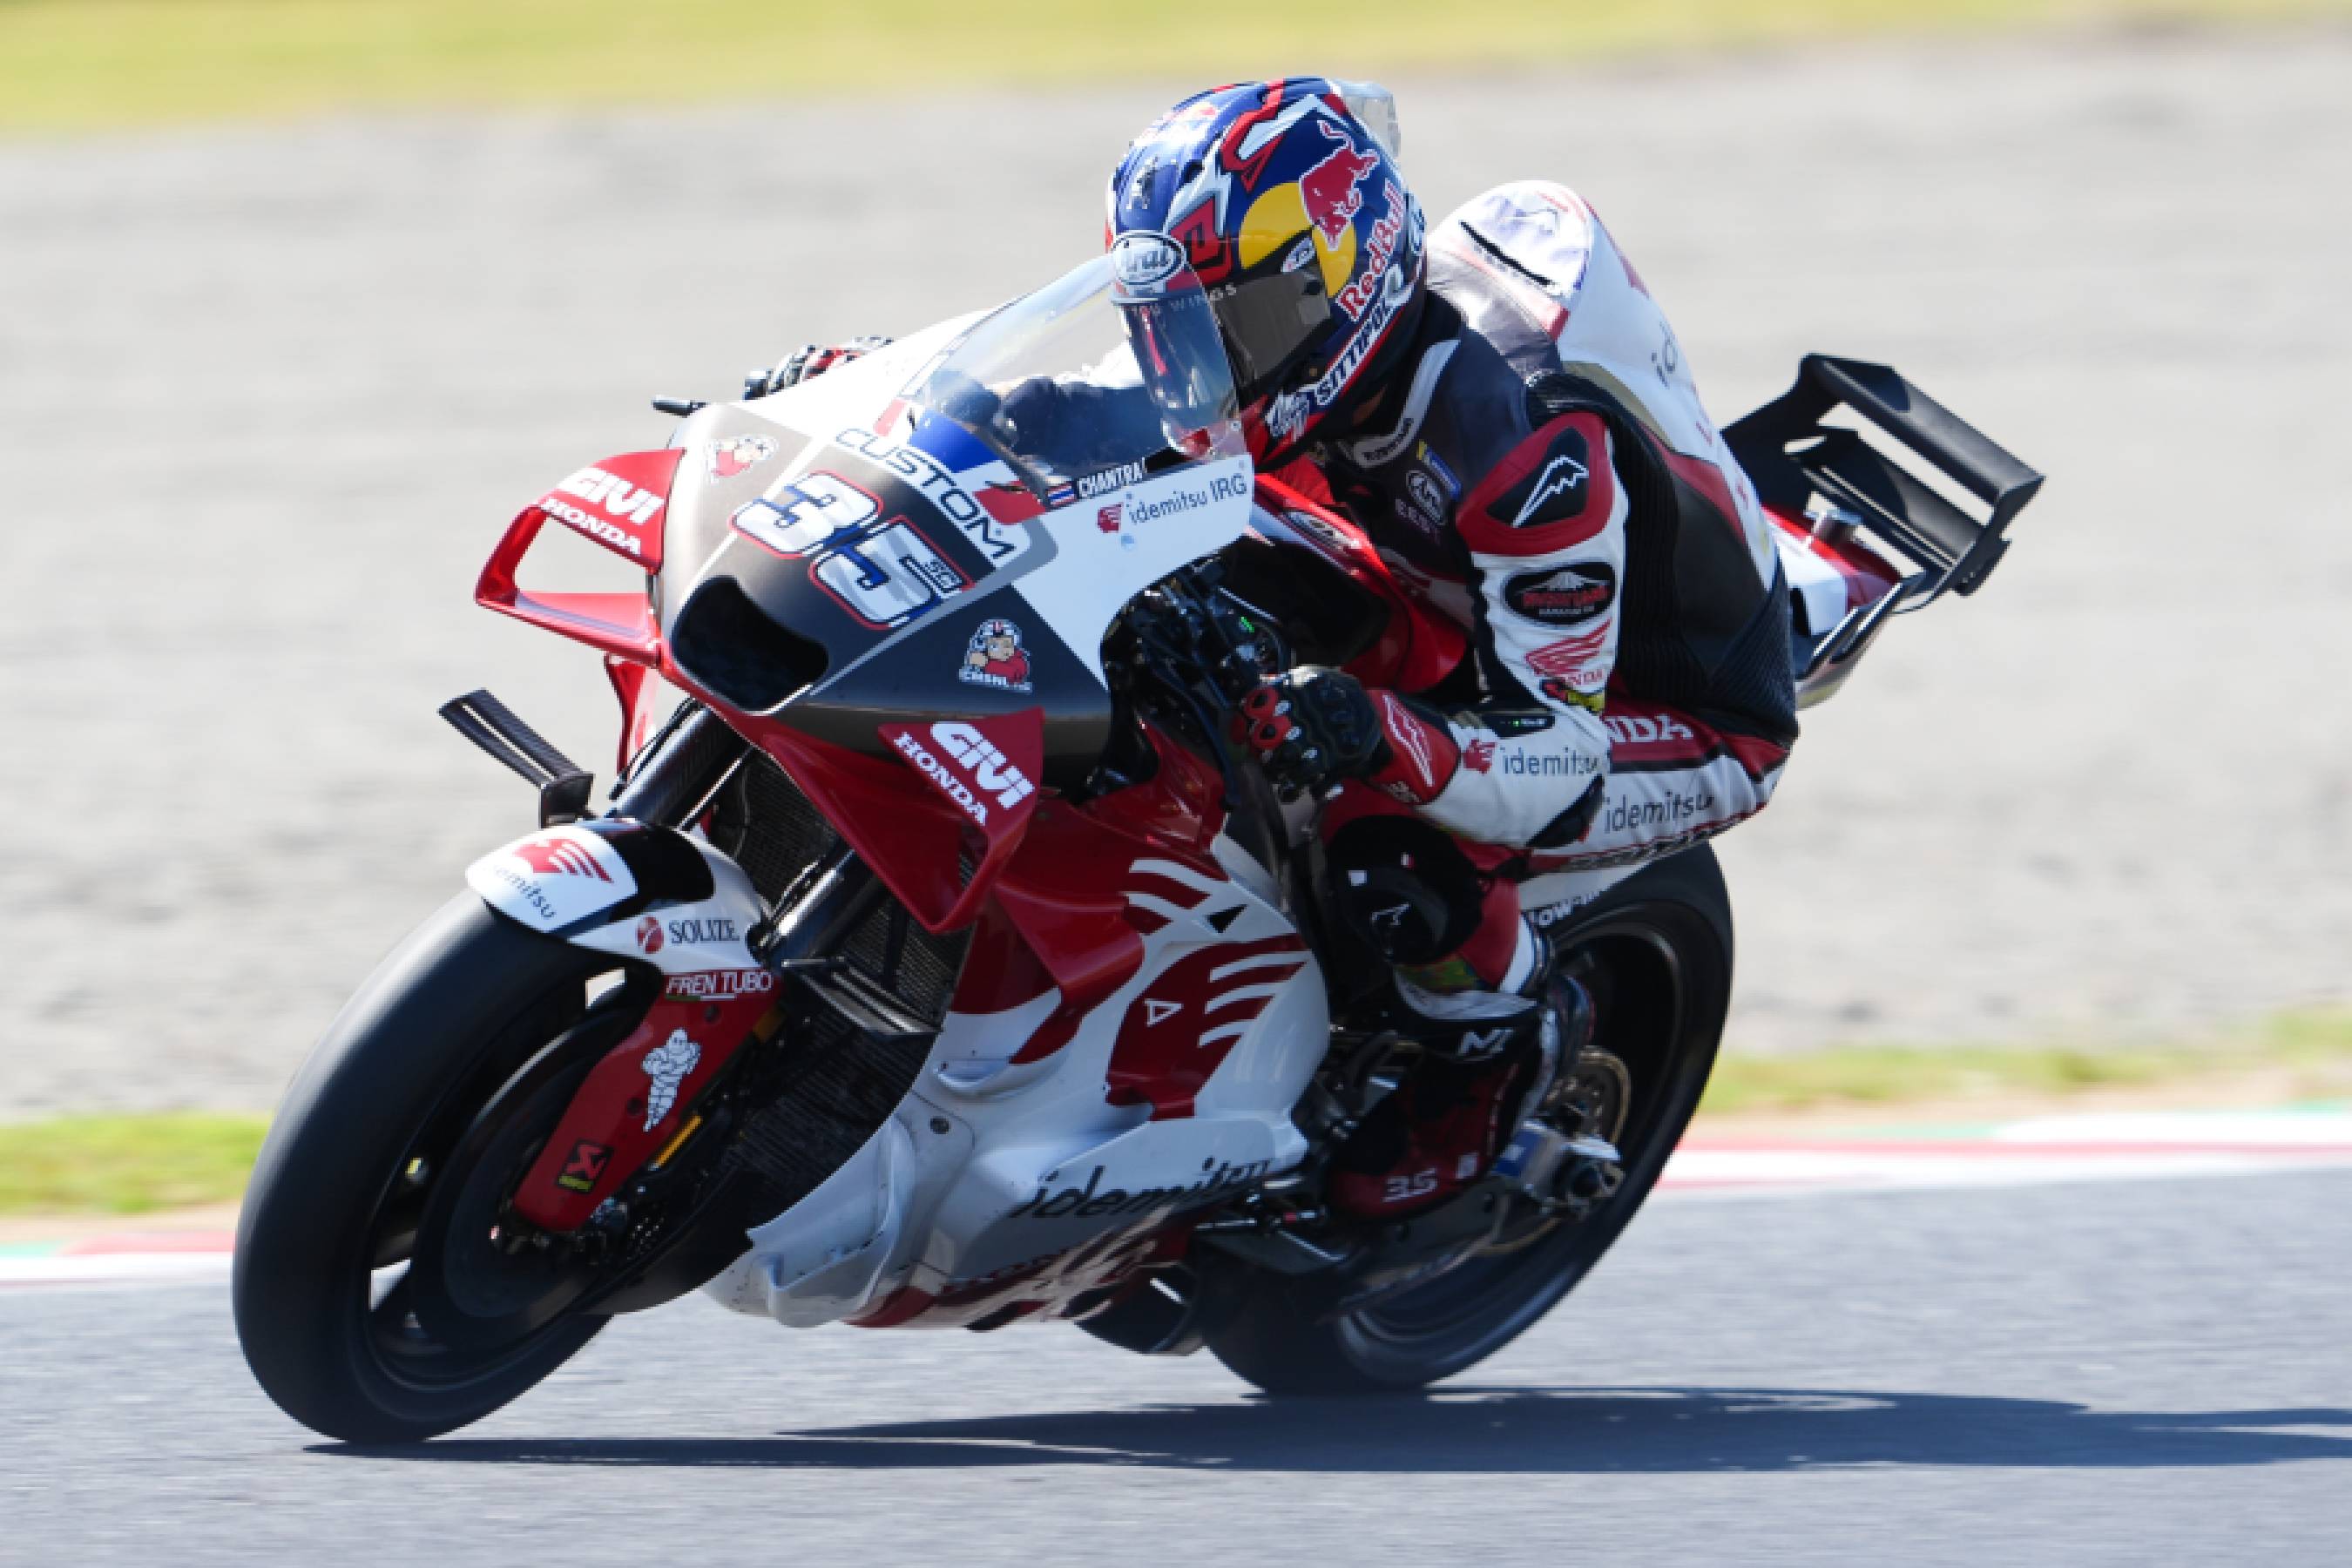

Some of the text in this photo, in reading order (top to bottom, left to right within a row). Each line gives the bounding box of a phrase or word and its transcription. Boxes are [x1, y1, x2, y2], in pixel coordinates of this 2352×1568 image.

[557, 467, 664, 524] GIVI
[836, 428, 1017, 560] CUSTOM
[1077, 461, 1143, 498] CHANTRA
[1128, 472, 1247, 525] idemitsu IRG
[541, 497, 643, 555] HONDA
[730, 470, 972, 629] 35
[1604, 713, 1694, 744] NDA
[894, 731, 989, 826] HONDA
[930, 720, 1034, 809] GIVI
[1499, 746, 1599, 776] idemitsu
[1604, 789, 1715, 834] idemitsu
[668, 918, 740, 944] SOLIZE
[666, 970, 774, 994] FREN TUBO
[1382, 1167, 1438, 1203] 35
